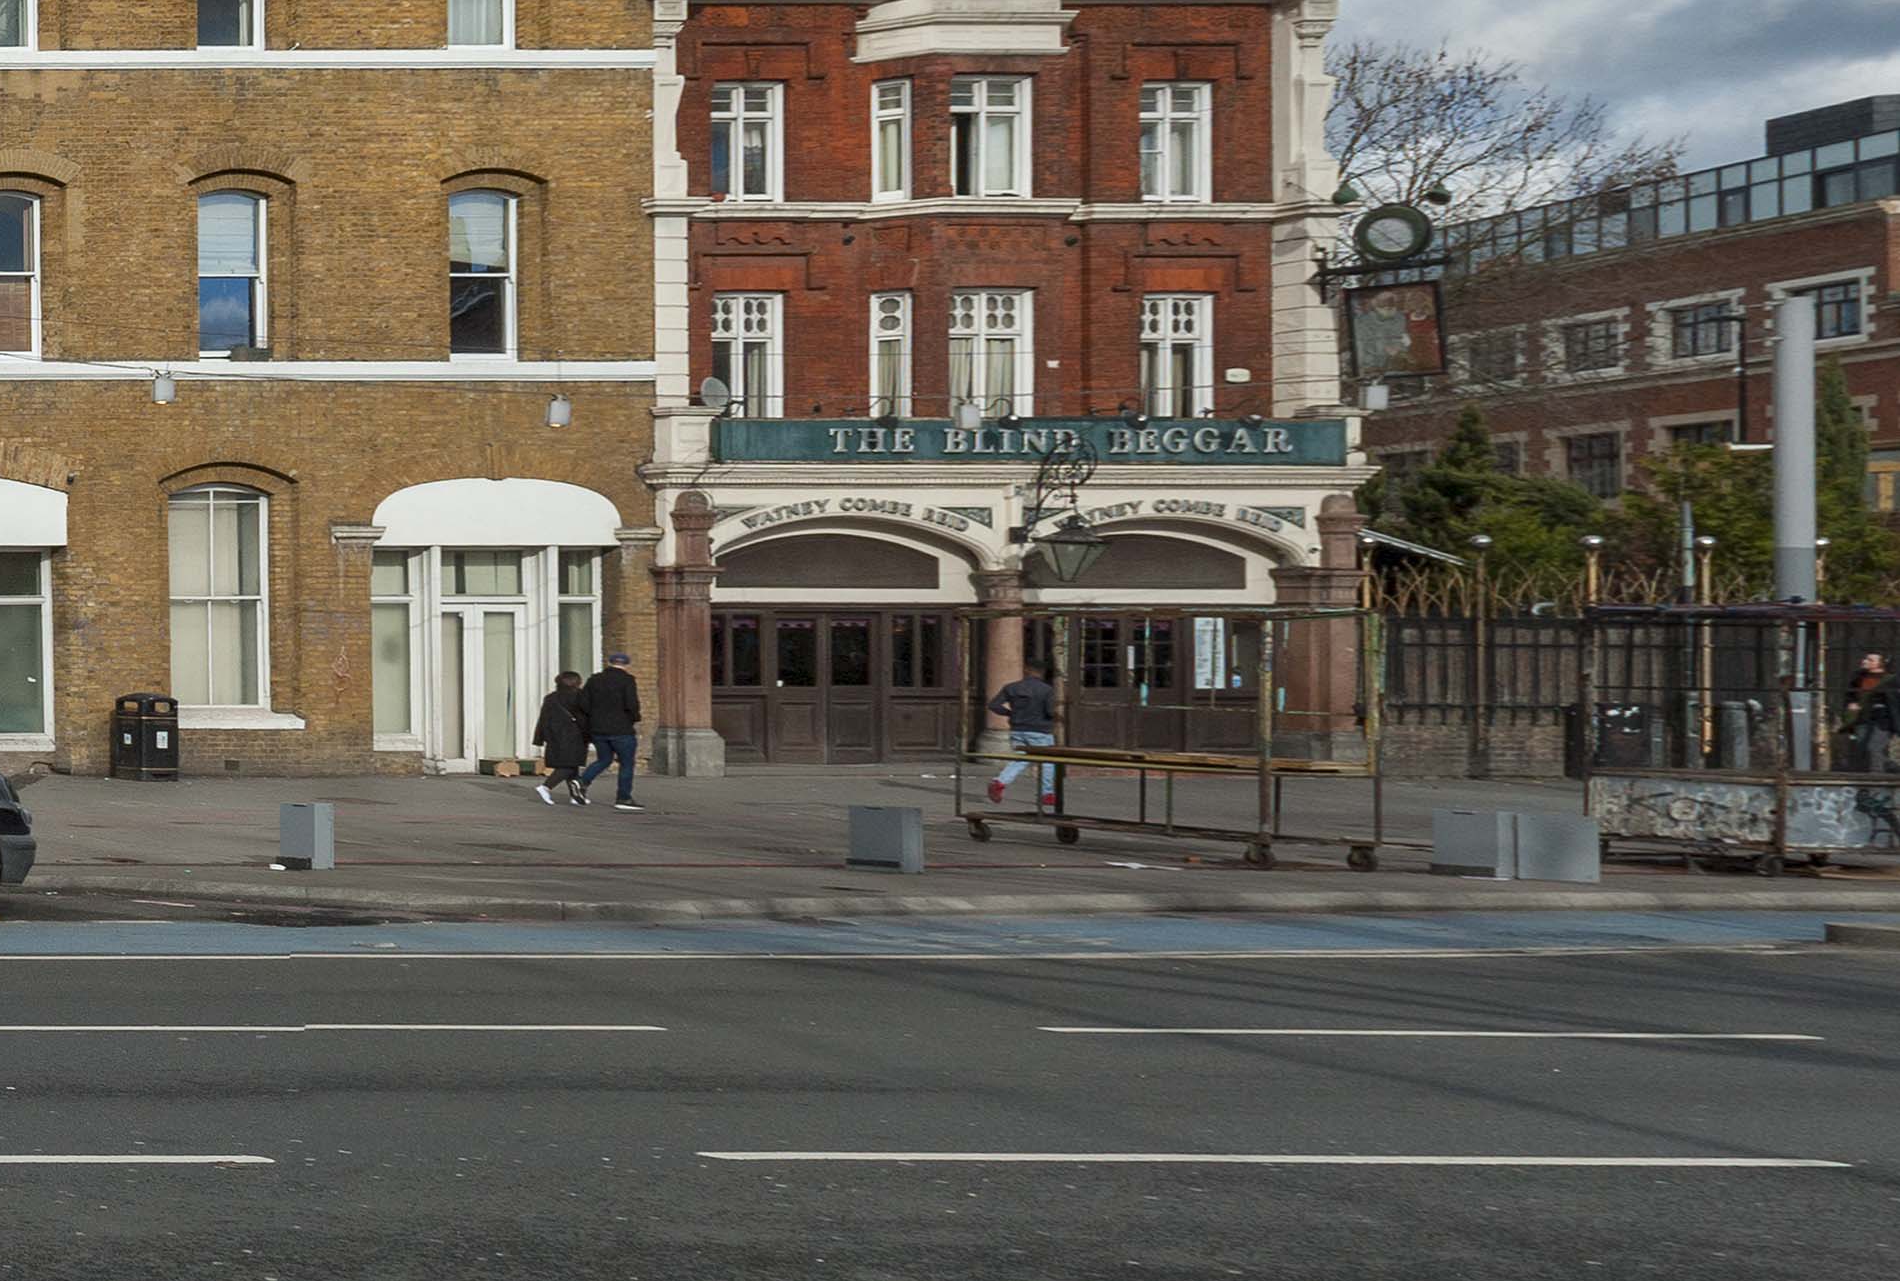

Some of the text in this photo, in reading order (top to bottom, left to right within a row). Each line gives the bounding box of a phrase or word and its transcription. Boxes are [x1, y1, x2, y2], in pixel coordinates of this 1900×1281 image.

[829, 425, 1294, 454] THE BLIND BEGGAR
[741, 498, 830, 529] WATNEY
[839, 497, 913, 517] COMBE
